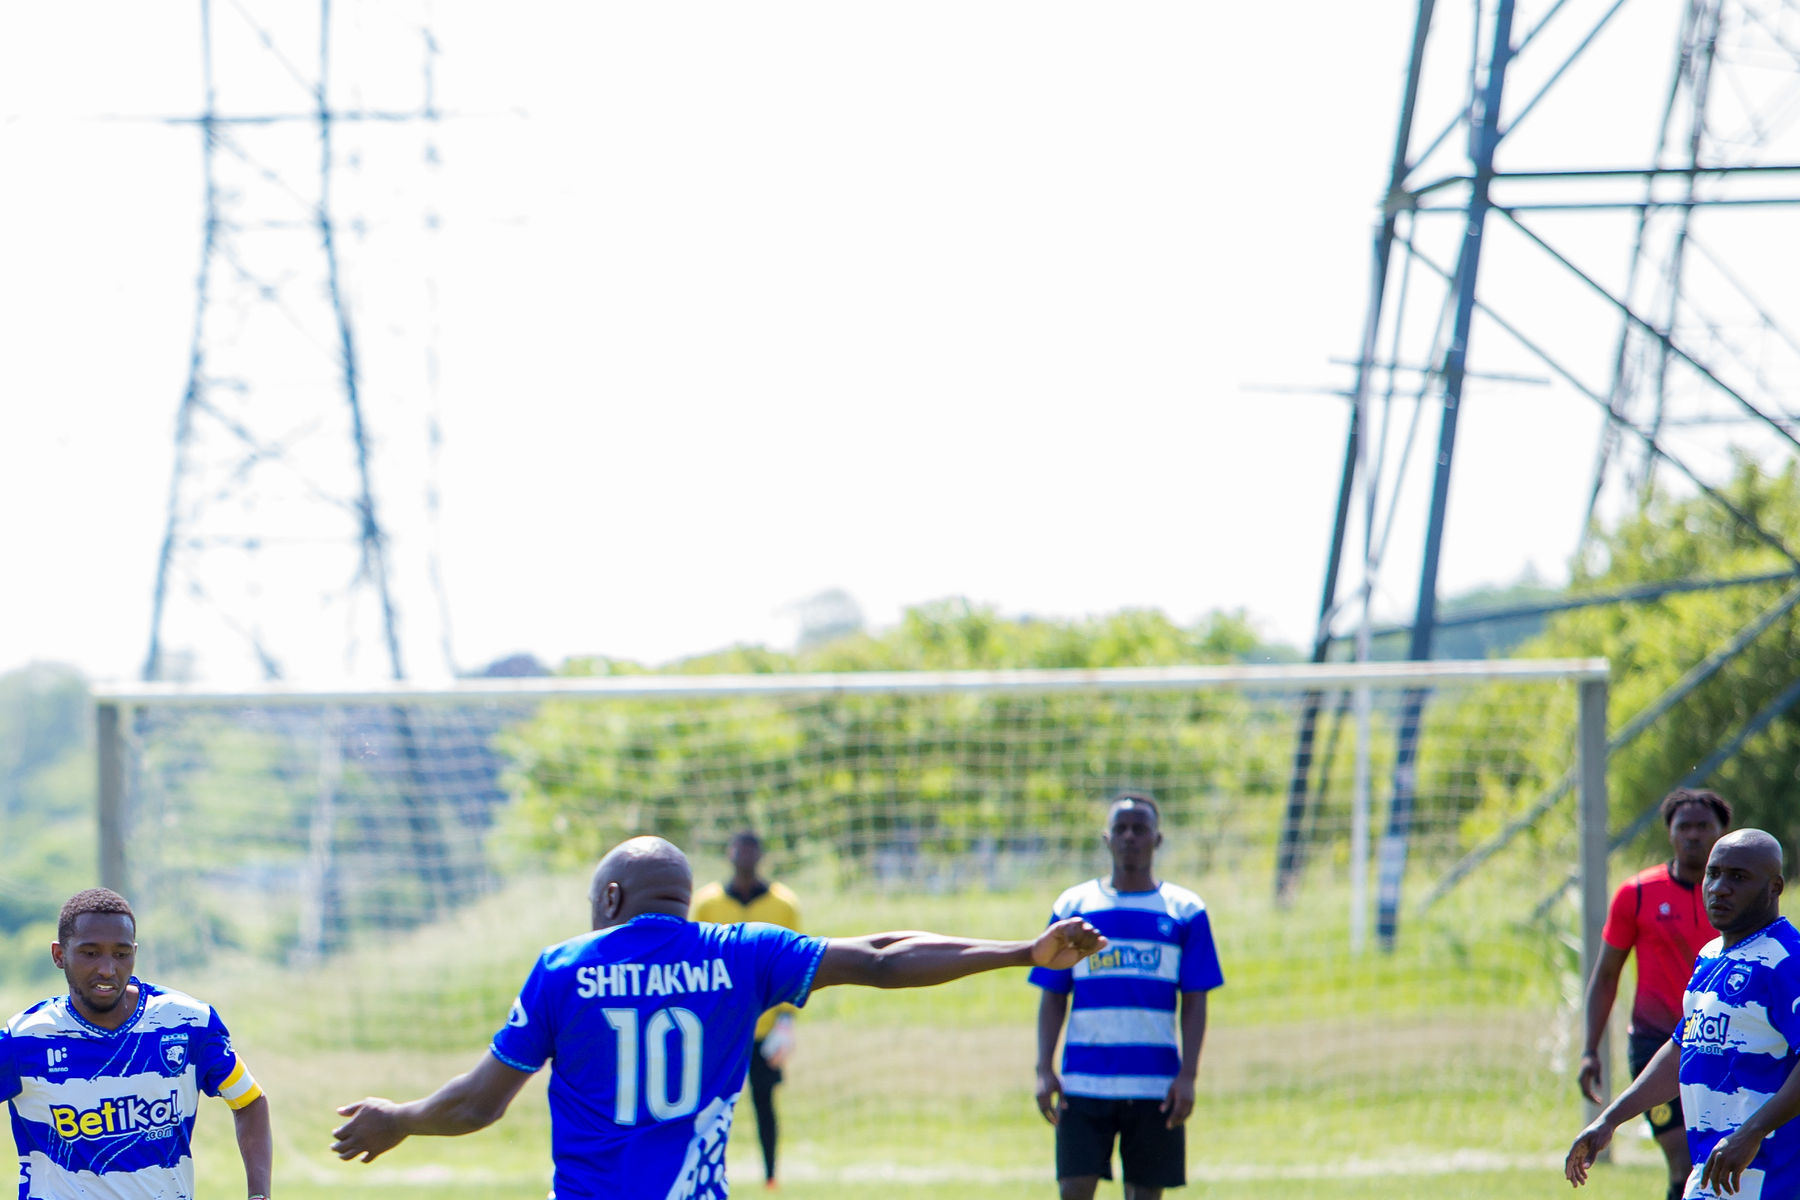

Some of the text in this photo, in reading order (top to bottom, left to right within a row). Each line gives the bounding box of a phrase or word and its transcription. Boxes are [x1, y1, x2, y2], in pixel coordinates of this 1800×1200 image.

[576, 958, 733, 998] SHITAKWA
[1683, 1011, 1729, 1045] tika!
[601, 1006, 704, 1126] 10
[51, 1090, 182, 1140] Betika!
